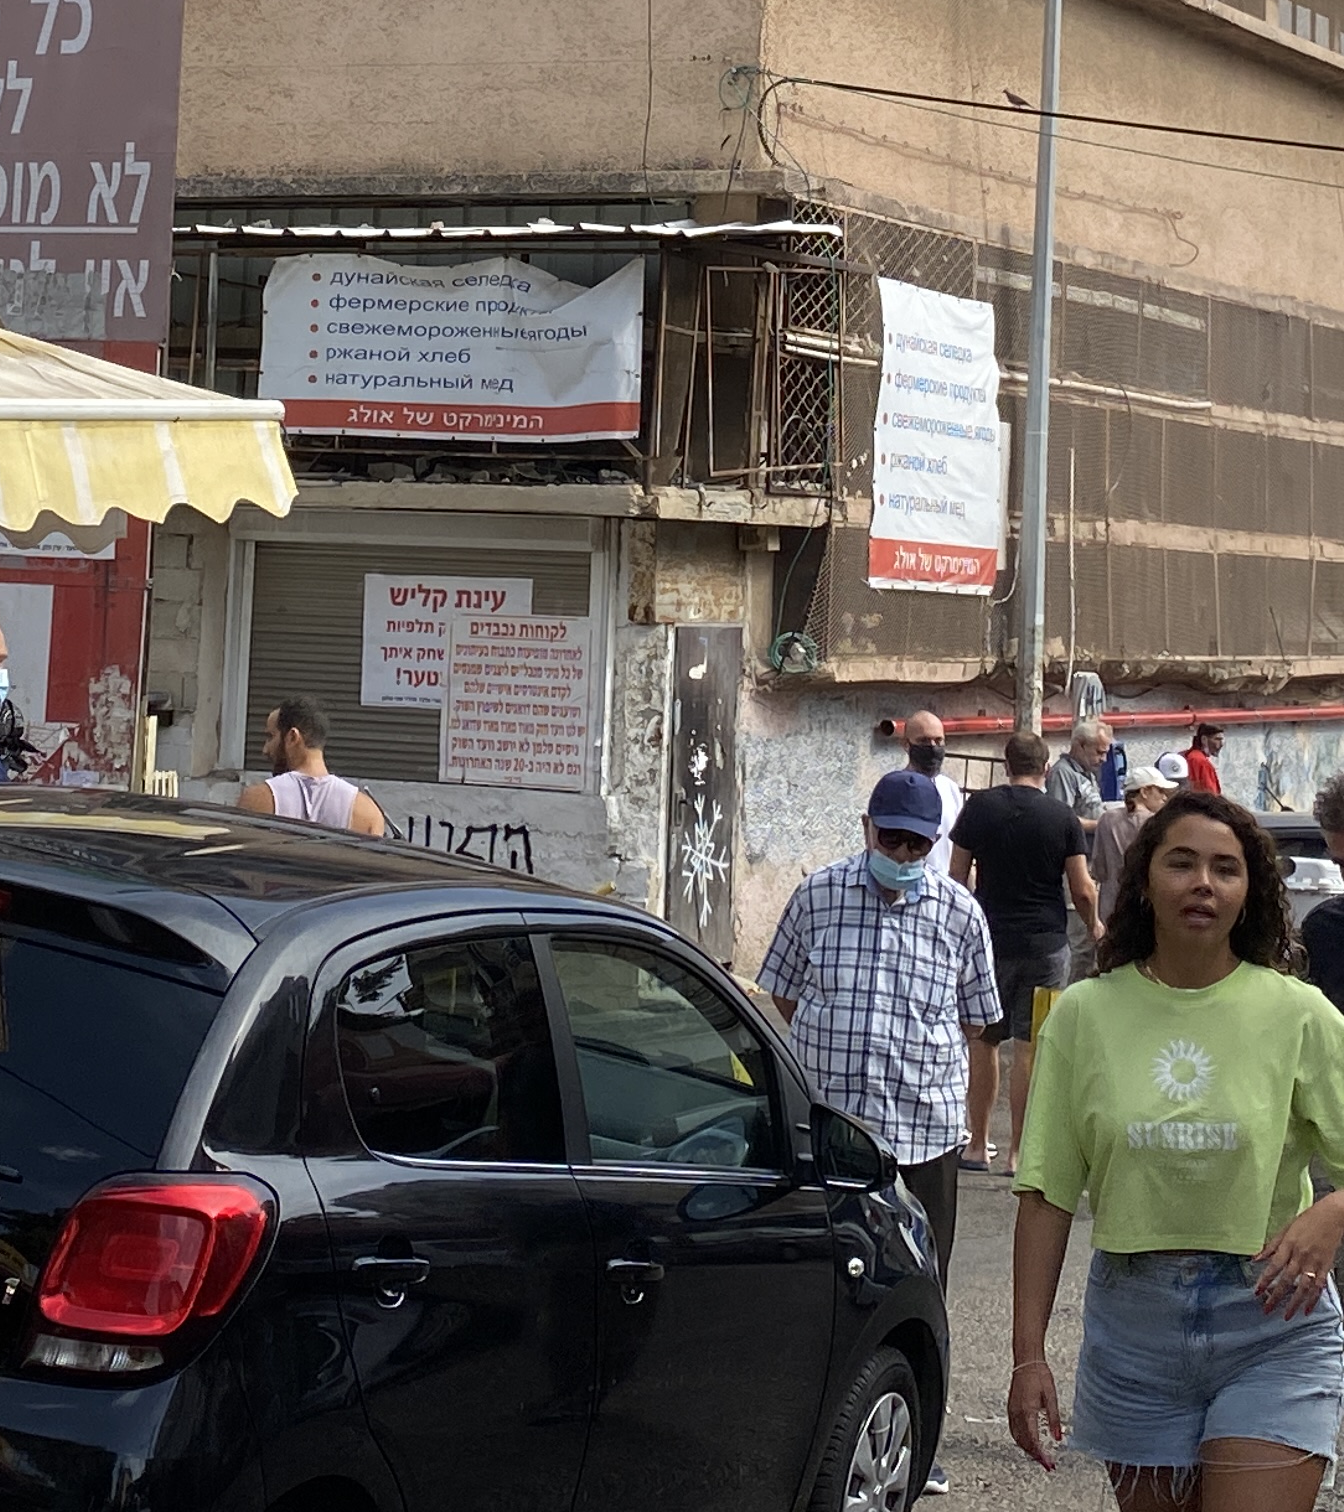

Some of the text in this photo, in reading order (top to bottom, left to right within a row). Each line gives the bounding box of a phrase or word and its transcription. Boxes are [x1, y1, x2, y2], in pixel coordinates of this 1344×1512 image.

[87, 141, 151, 224] לא
[330, 271, 446, 289] дунайская
[329, 293, 469, 314] фермерские
[325, 346, 472, 364] ржаной хлеб
[325, 372, 514, 394] натуральный мед
[347, 403, 394, 424] אולג
[402, 406, 434, 426] של
[893, 545, 916, 570] אולג
[918, 547, 932, 572] של
[389, 583, 506, 613] עינת קליש
[386, 618, 434, 634] תלפיות
[470, 621, 567, 643] לקוחות נכבדים
[380, 646, 413, 662] איתך
